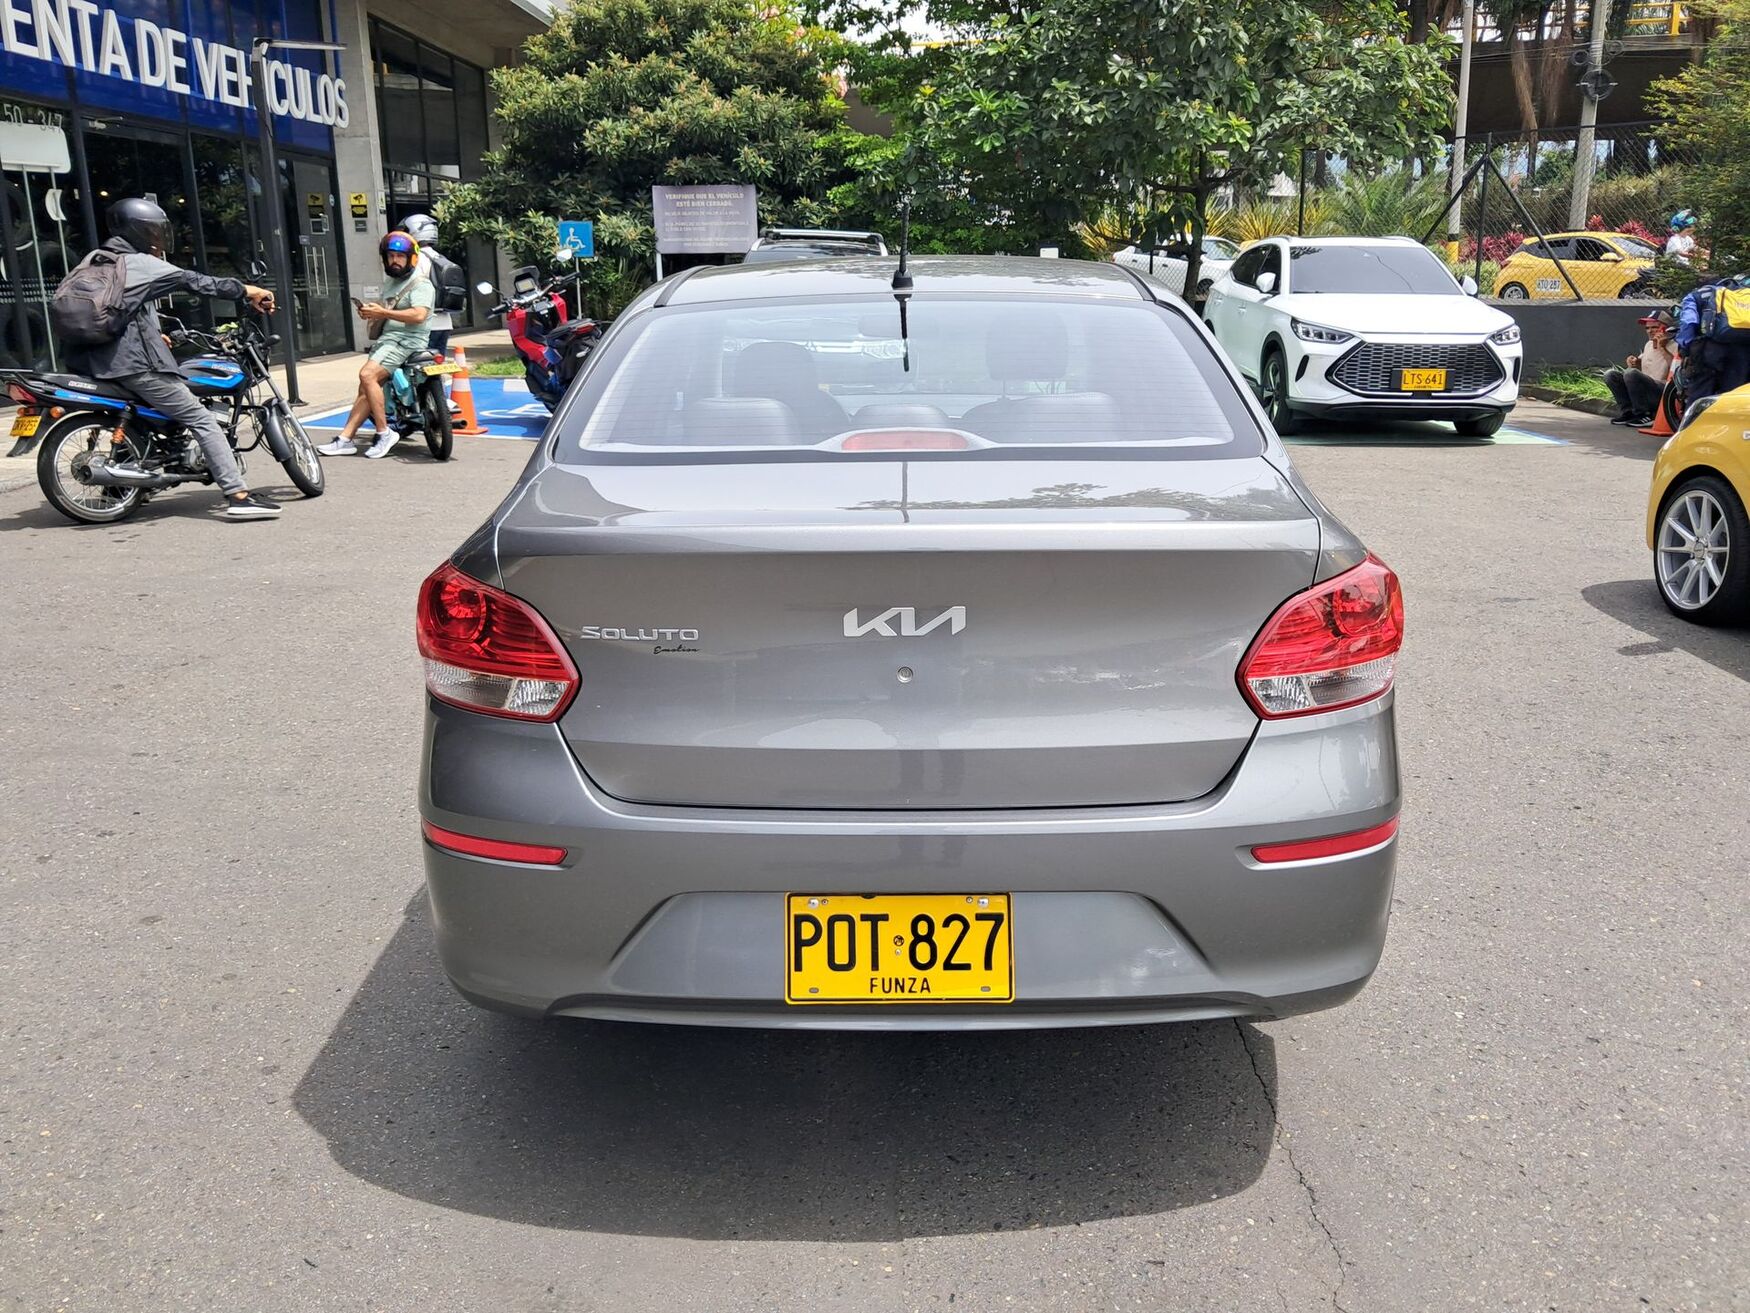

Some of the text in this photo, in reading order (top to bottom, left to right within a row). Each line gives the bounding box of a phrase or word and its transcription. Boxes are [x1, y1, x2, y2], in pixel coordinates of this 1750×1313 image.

[134, 18, 191, 94] DE
[3, 103, 24, 127] 50
[37, 109, 63, 134] 347
[1403, 373, 1443, 385] LTS 641
[580, 625, 699, 641] SOLUTO
[843, 605, 967, 638] KIA
[653, 644, 700, 655] Emotion
[793, 914, 1005, 973] POT 827
[869, 977, 931, 994] FUNZA
